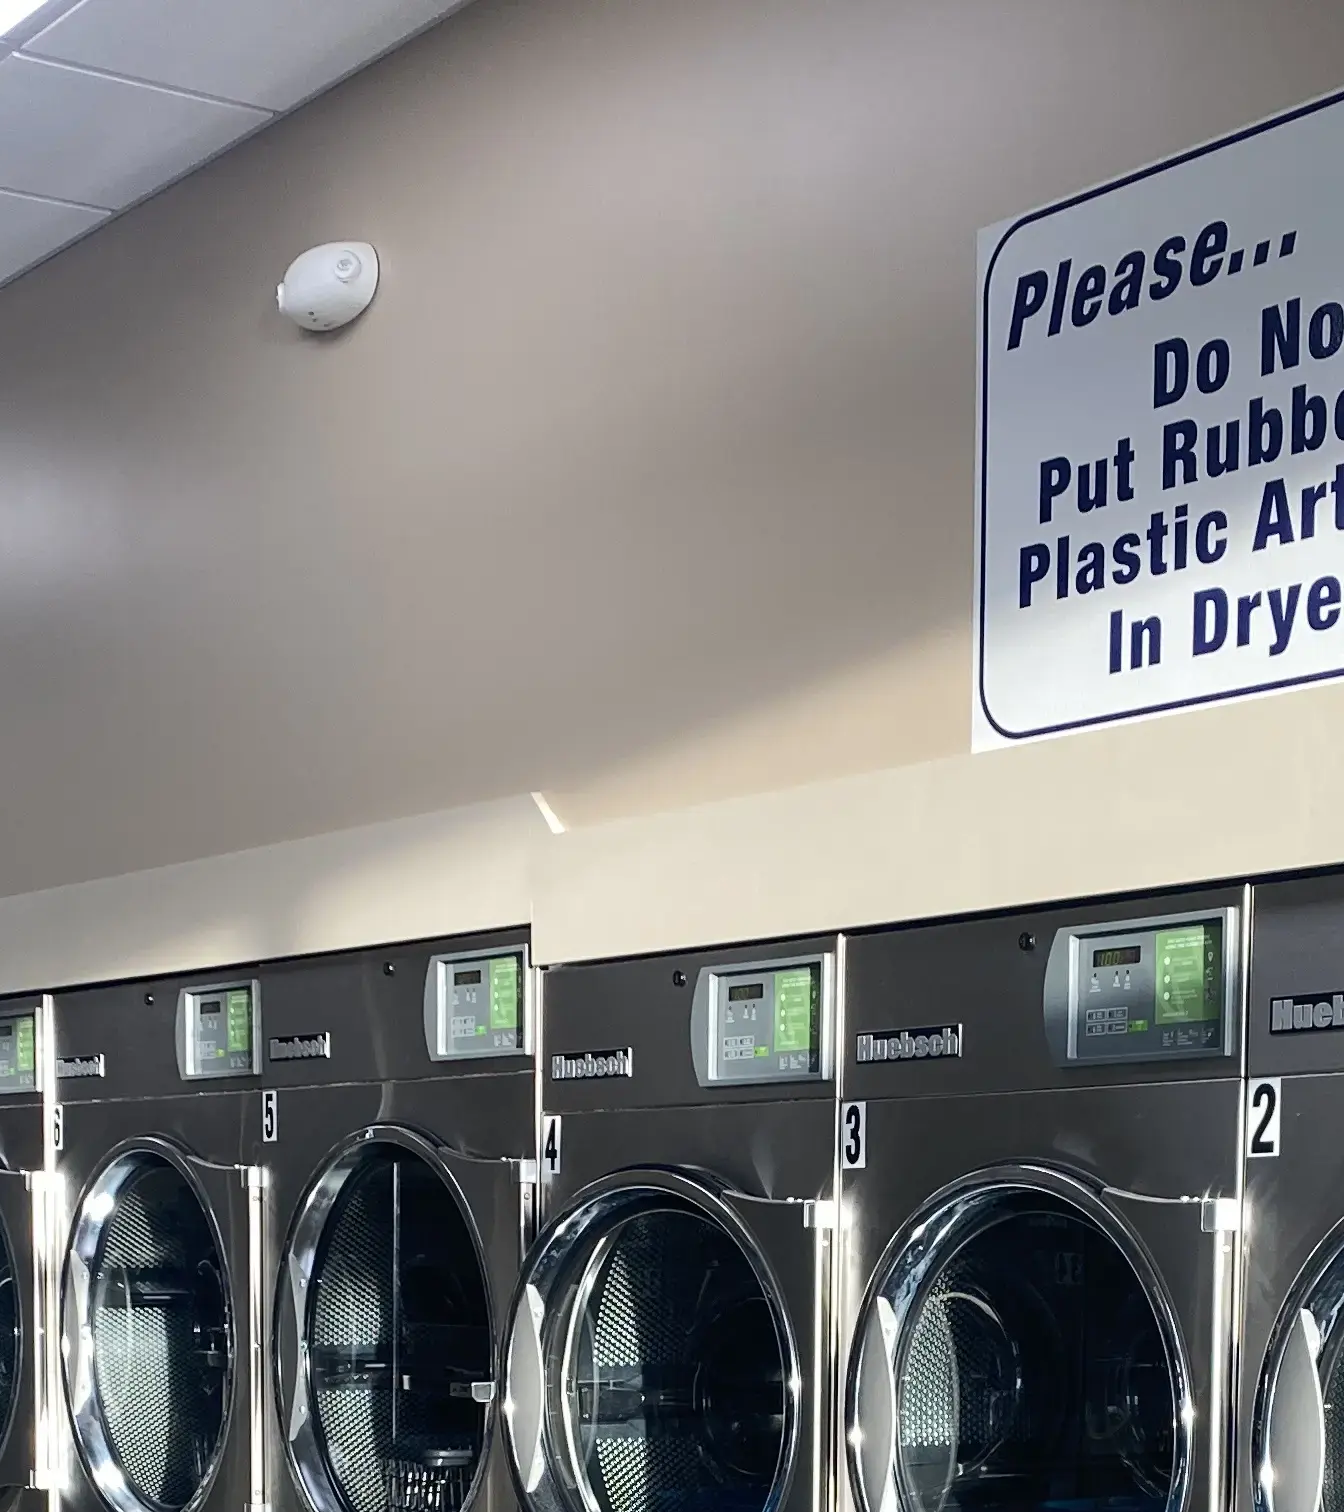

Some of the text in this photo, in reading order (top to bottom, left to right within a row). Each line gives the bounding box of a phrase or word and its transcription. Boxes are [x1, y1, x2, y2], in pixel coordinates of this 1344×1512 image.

[1006, 218, 1298, 351] Please...
[1153, 337, 1230, 409] Do
[1039, 437, 1135, 524] Put
[1019, 507, 1229, 608] Plastic
[1109, 609, 1162, 675] In
[857, 1028, 958, 1062] Huebsch
[53, 1107, 60, 1147] 6
[265, 1093, 274, 1139] 5
[545, 1118, 557, 1171] 4
[846, 1105, 861, 1165] 3
[1251, 1083, 1276, 1154] 2
